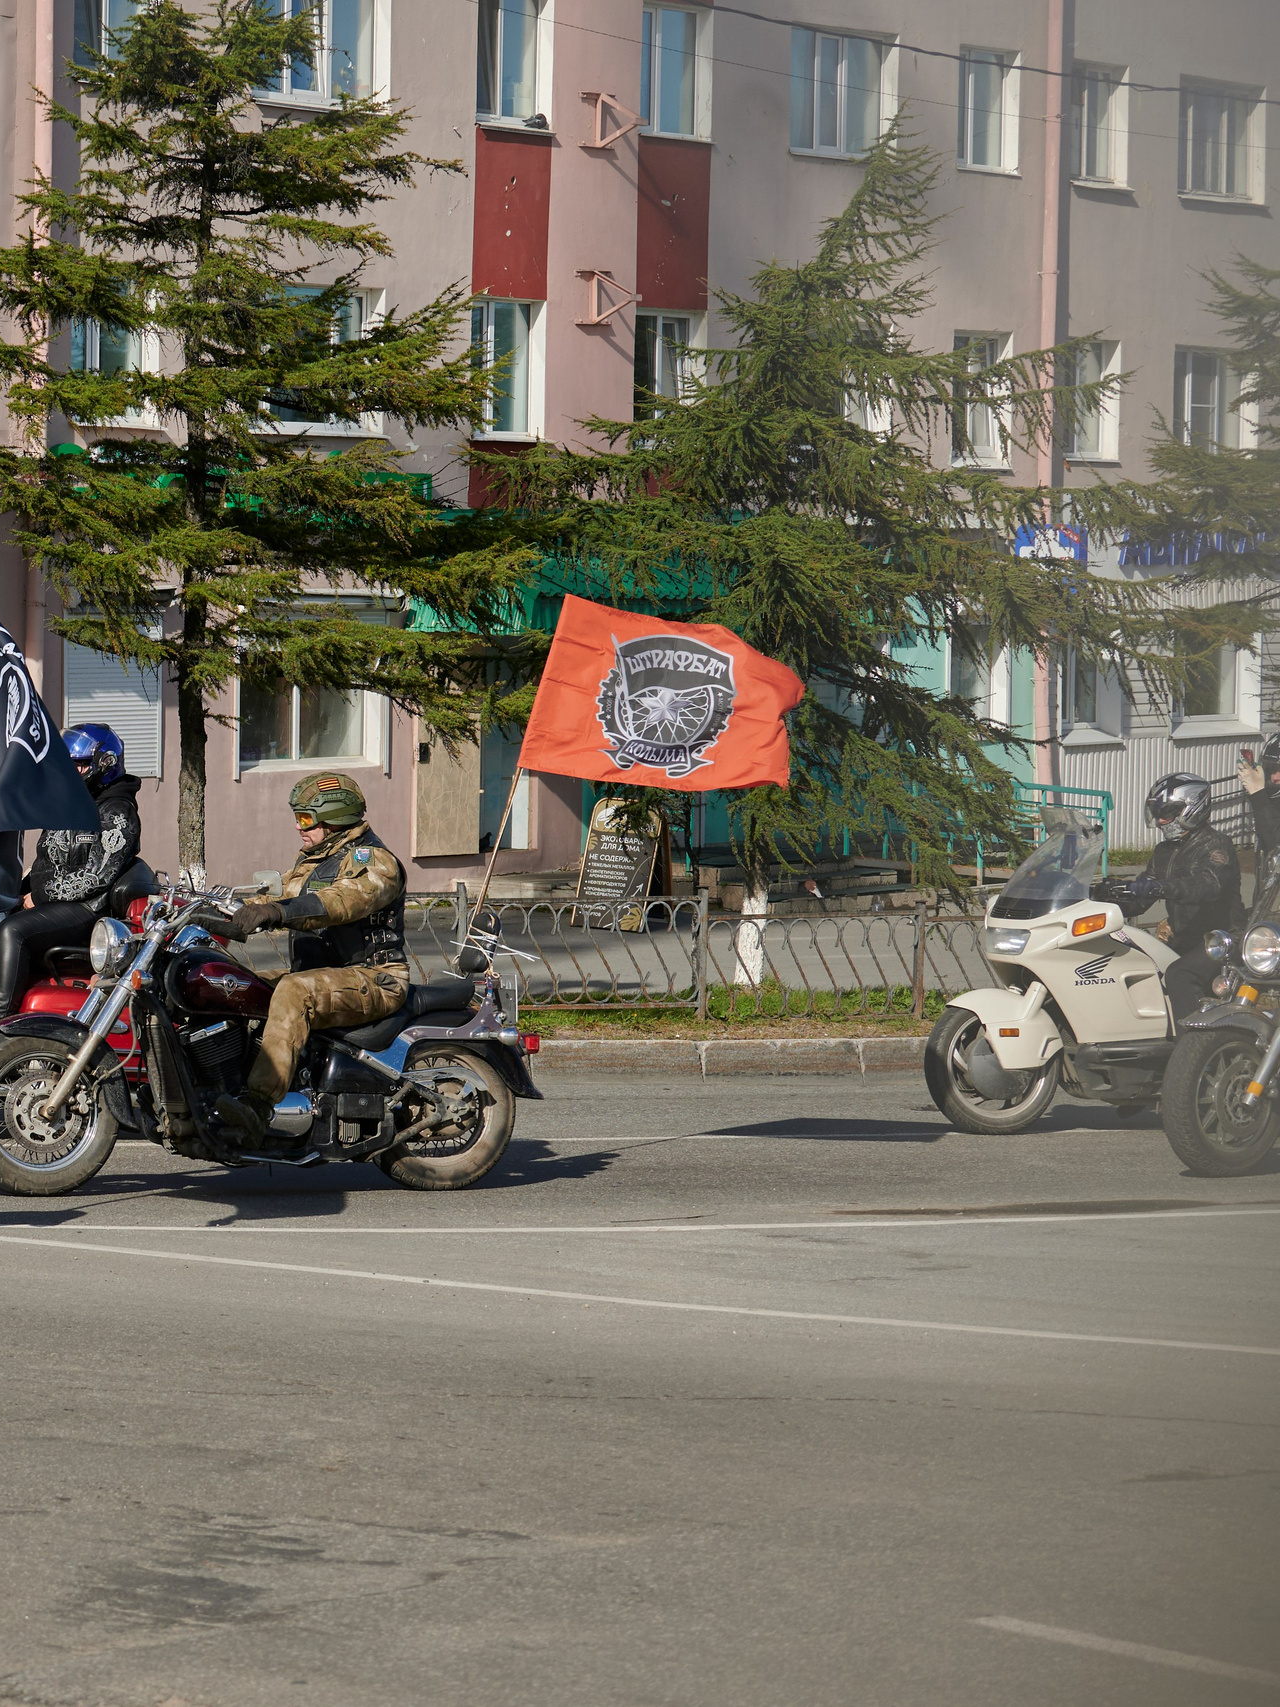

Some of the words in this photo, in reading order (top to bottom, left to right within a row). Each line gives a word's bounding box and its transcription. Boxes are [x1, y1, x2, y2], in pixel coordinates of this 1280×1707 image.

[625, 649, 727, 679] ШТРАФБАТ
[625, 741, 686, 762] КОЛЫМА
[601, 842, 617, 851] ДЛЯ
[600, 854, 637, 863] СОДЕРЖТ
[1075, 978, 1116, 986] HONDA
